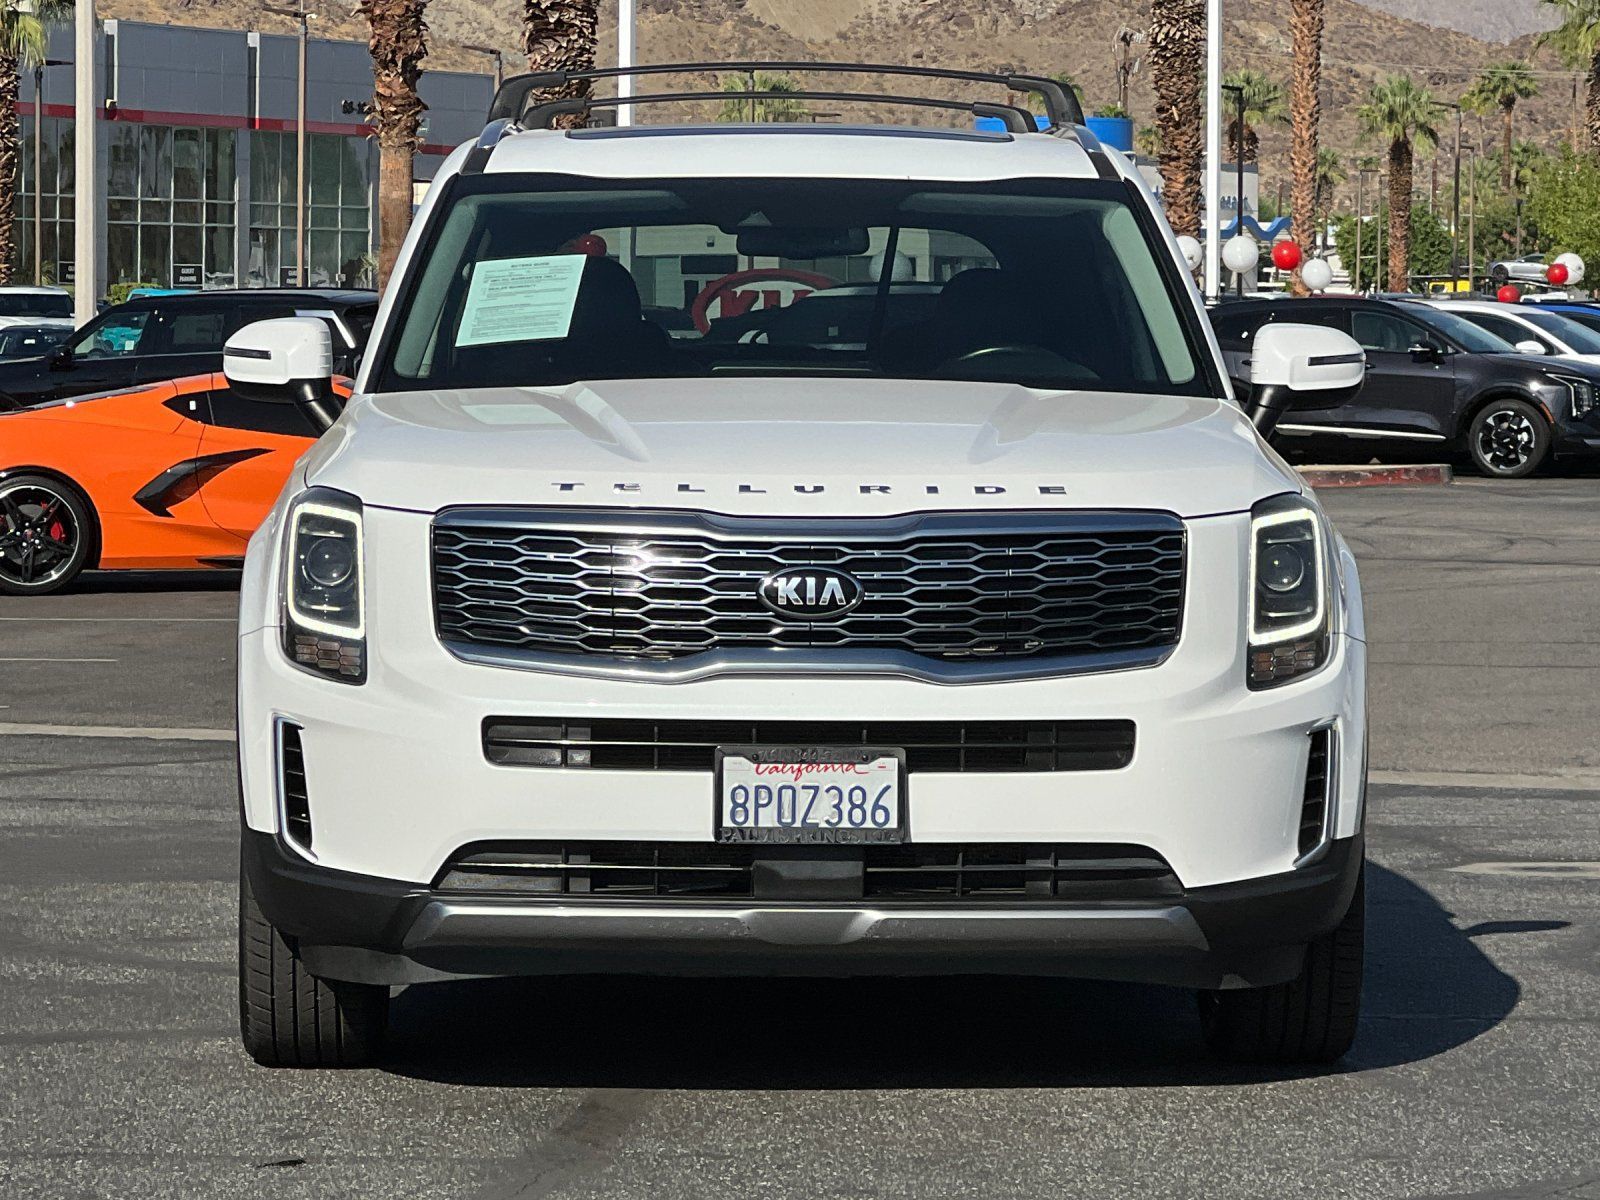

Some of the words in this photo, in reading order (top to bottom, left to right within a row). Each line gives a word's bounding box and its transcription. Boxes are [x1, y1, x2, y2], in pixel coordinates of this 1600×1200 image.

[720, 289, 815, 318] KI
[551, 482, 1067, 496] TELLURIDE
[776, 577, 847, 605] KIA
[755, 762, 869, 782] California
